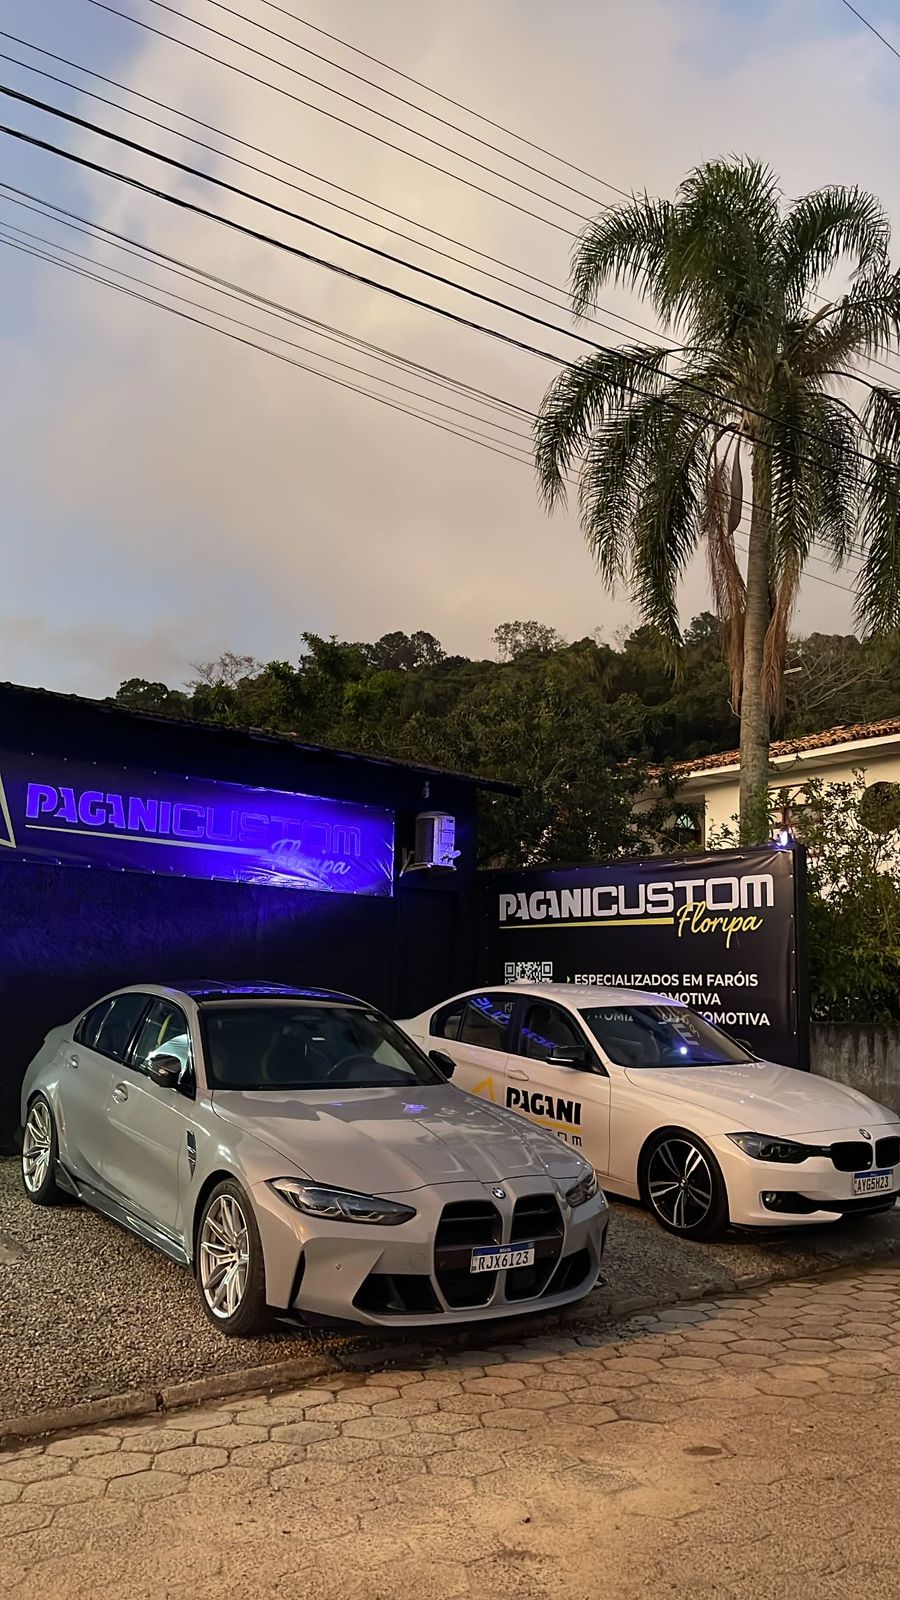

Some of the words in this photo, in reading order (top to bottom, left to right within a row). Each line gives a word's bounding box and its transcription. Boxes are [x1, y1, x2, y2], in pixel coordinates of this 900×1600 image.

[272, 839, 351, 878] Flipa
[676, 901, 763, 949] Floripa
[574, 973, 680, 987] ESPECIALIZADOS
[682, 973, 703, 987] EM
[706, 971, 759, 987] FARÓIS
[649, 992, 722, 1006] MOTIVA
[506, 1086, 582, 1125] PAGANI
